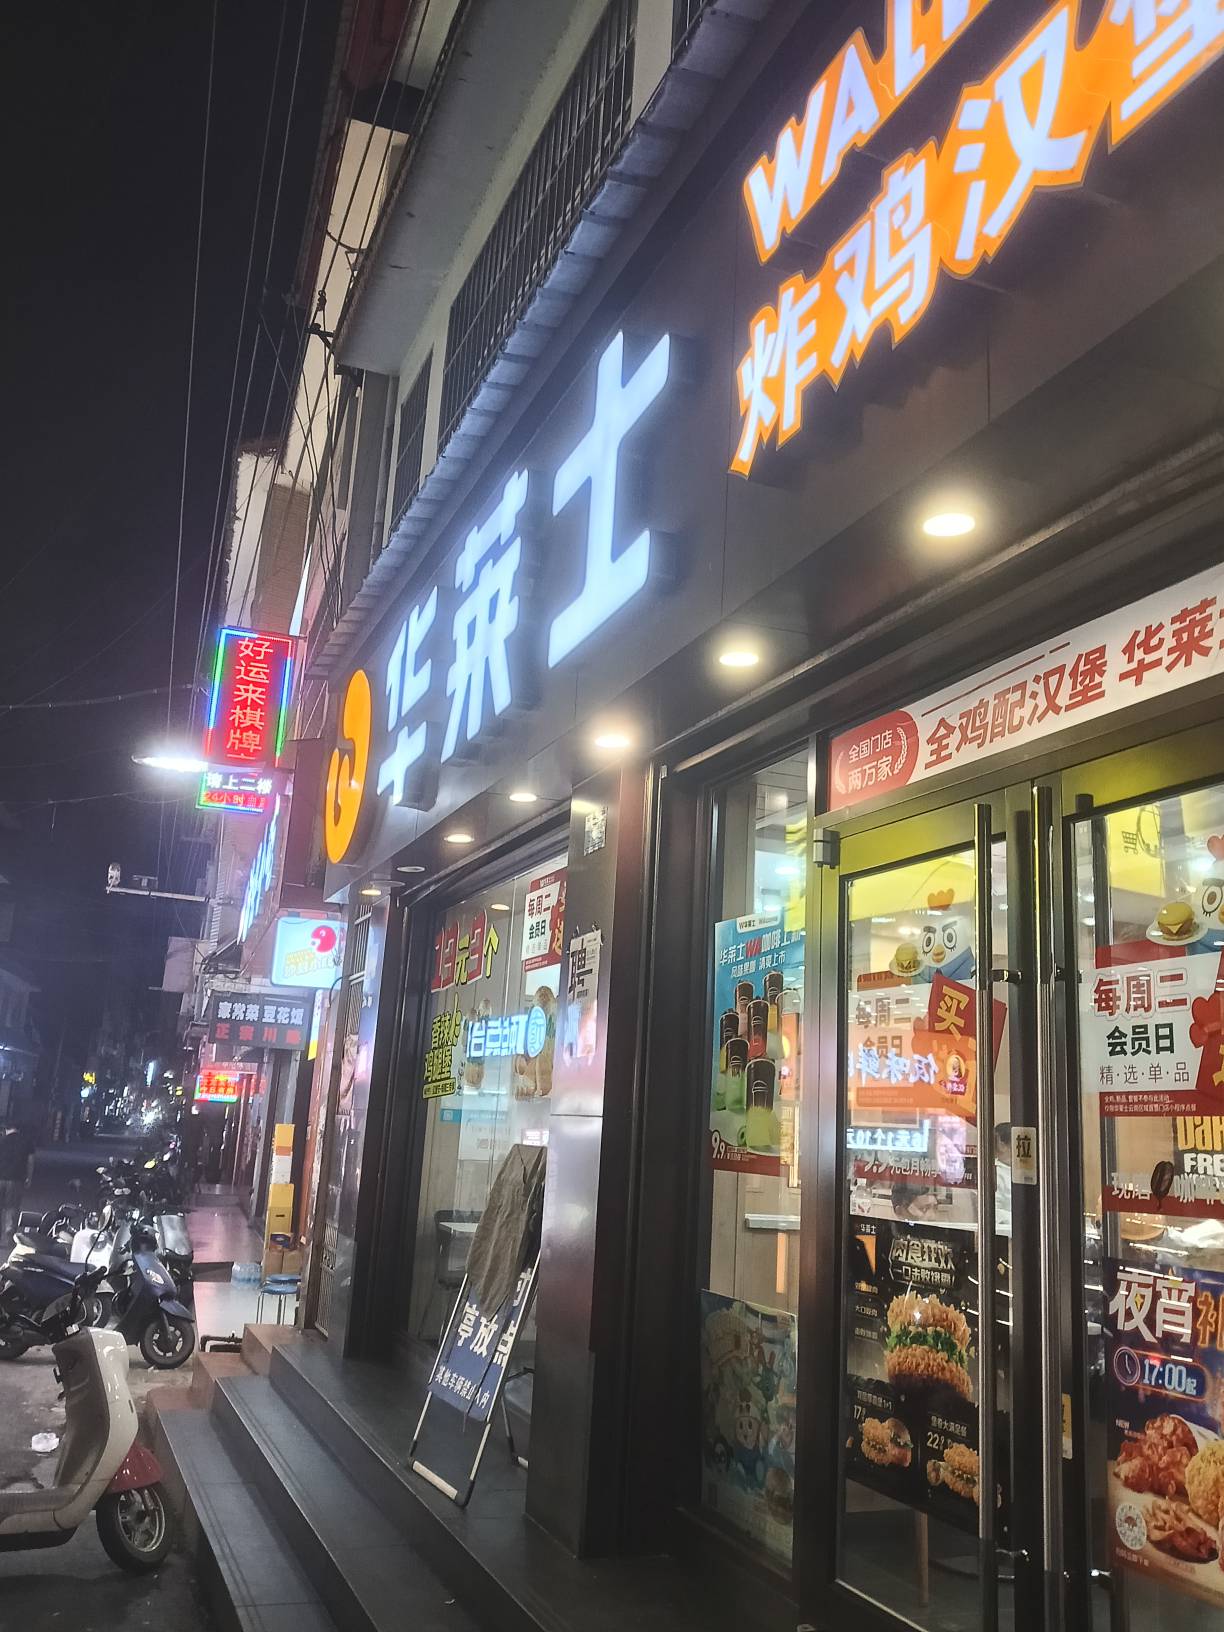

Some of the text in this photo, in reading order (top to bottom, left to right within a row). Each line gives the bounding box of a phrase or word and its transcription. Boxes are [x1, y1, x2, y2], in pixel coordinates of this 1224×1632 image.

[748, 0, 970, 249] WAL
[738, 0, 1224, 461] 炸鸡汉堡
[377, 329, 669, 807] 华莱士
[924, 596, 1224, 771] 全鸡配汉堡 华莱
[848, 729, 893, 763] 全国门店
[848, 755, 893, 794] 两万家
[528, 893, 551, 918] 每周二
[529, 919, 546, 940] 会员日
[218, 1001, 260, 1021] 家常菜
[935, 985, 969, 1040] 买
[1094, 972, 1188, 1017] 每周二
[1106, 1023, 1174, 1056] 会员日
[1016, 1134, 1032, 1158] 拉
